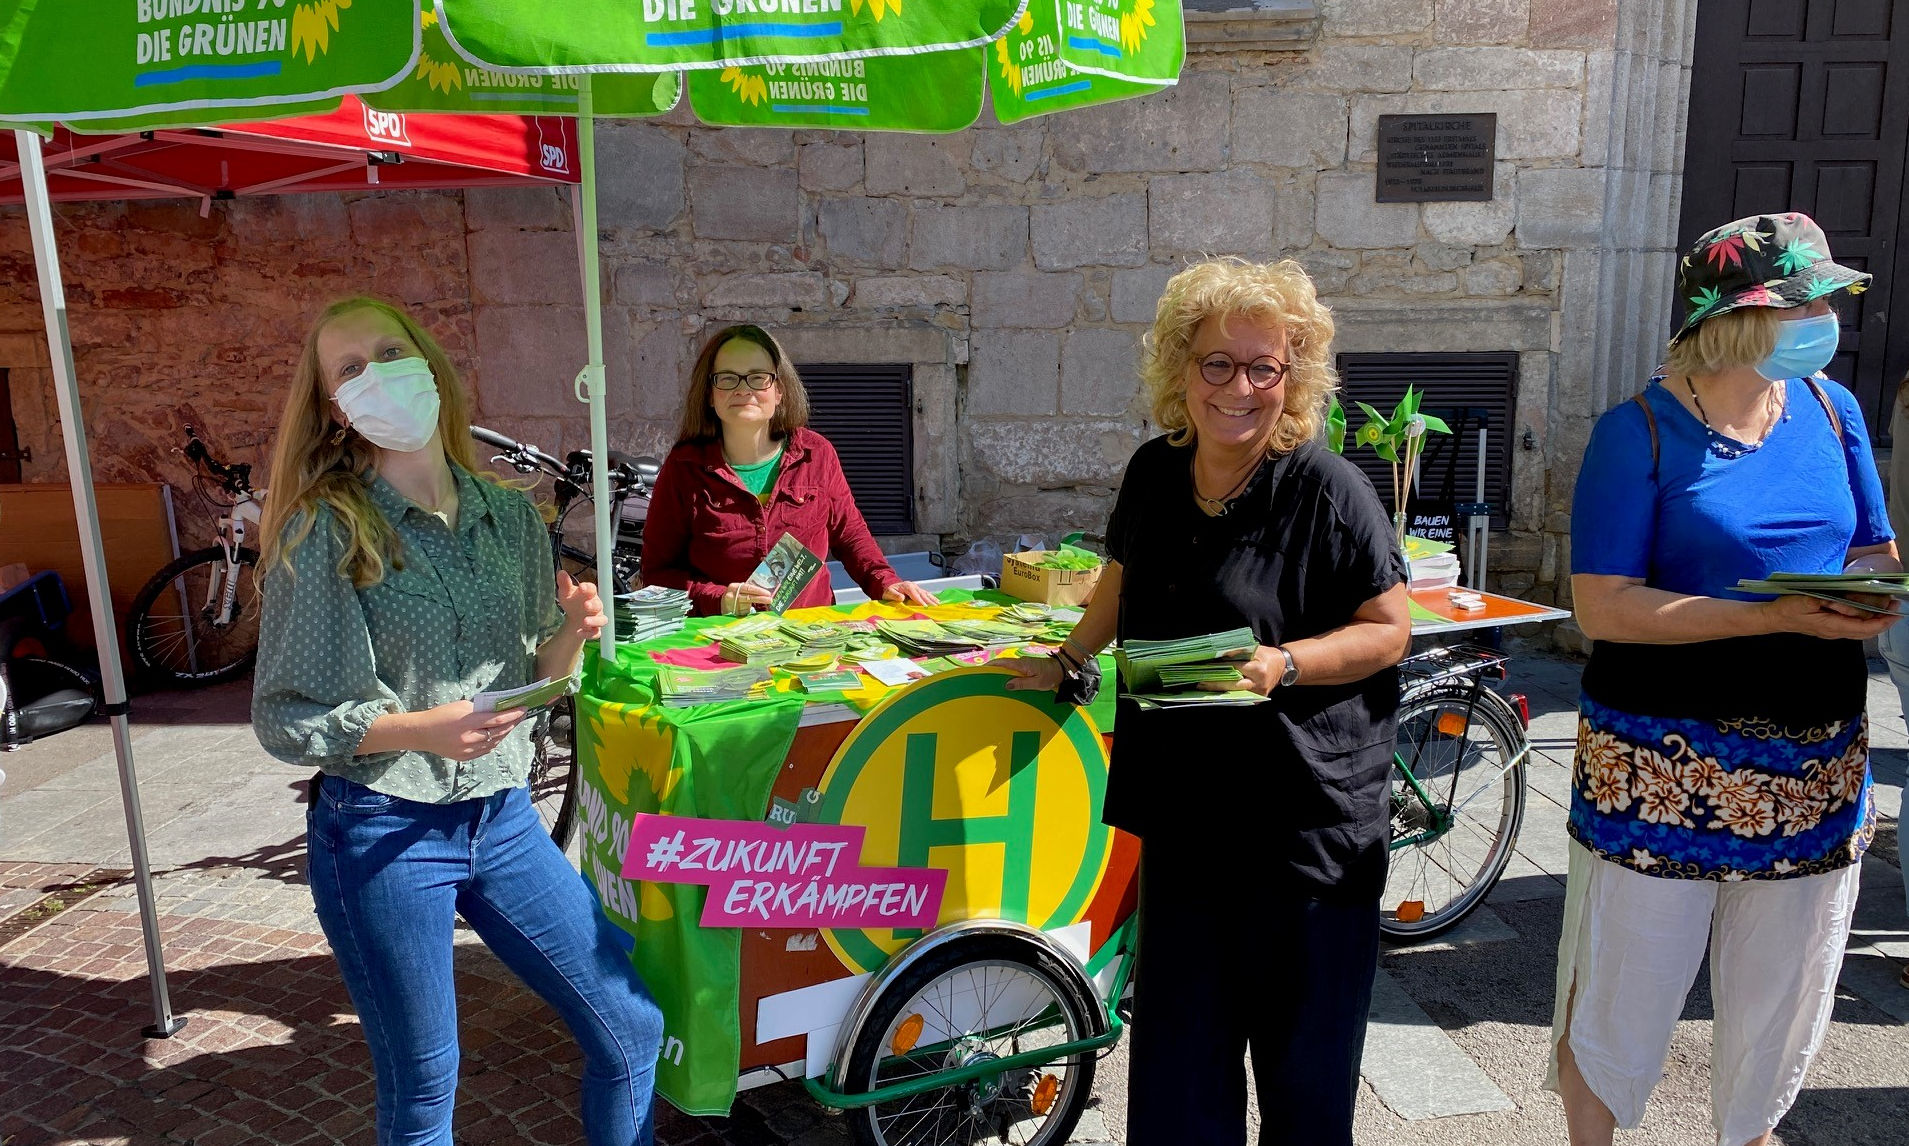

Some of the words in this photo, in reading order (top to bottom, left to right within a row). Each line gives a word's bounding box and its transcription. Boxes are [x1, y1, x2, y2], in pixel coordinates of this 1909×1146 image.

[1066, 1, 1084, 30] DIE
[137, 29, 171, 64] DIE
[178, 15, 286, 56] GRÜNEN
[368, 109, 401, 137] SPD
[543, 143, 564, 168] SPD
[1409, 528, 1426, 539] WIR
[1428, 528, 1453, 539] EINE
[1414, 515, 1450, 526] BAUEN
[1013, 567, 1040, 581] EuroBox
[775, 600, 785, 612] DIE
[607, 811, 630, 864] 90
[646, 830, 848, 877] #ZUKUNFT
[723, 876, 929, 920] ERKÄMPFEN
